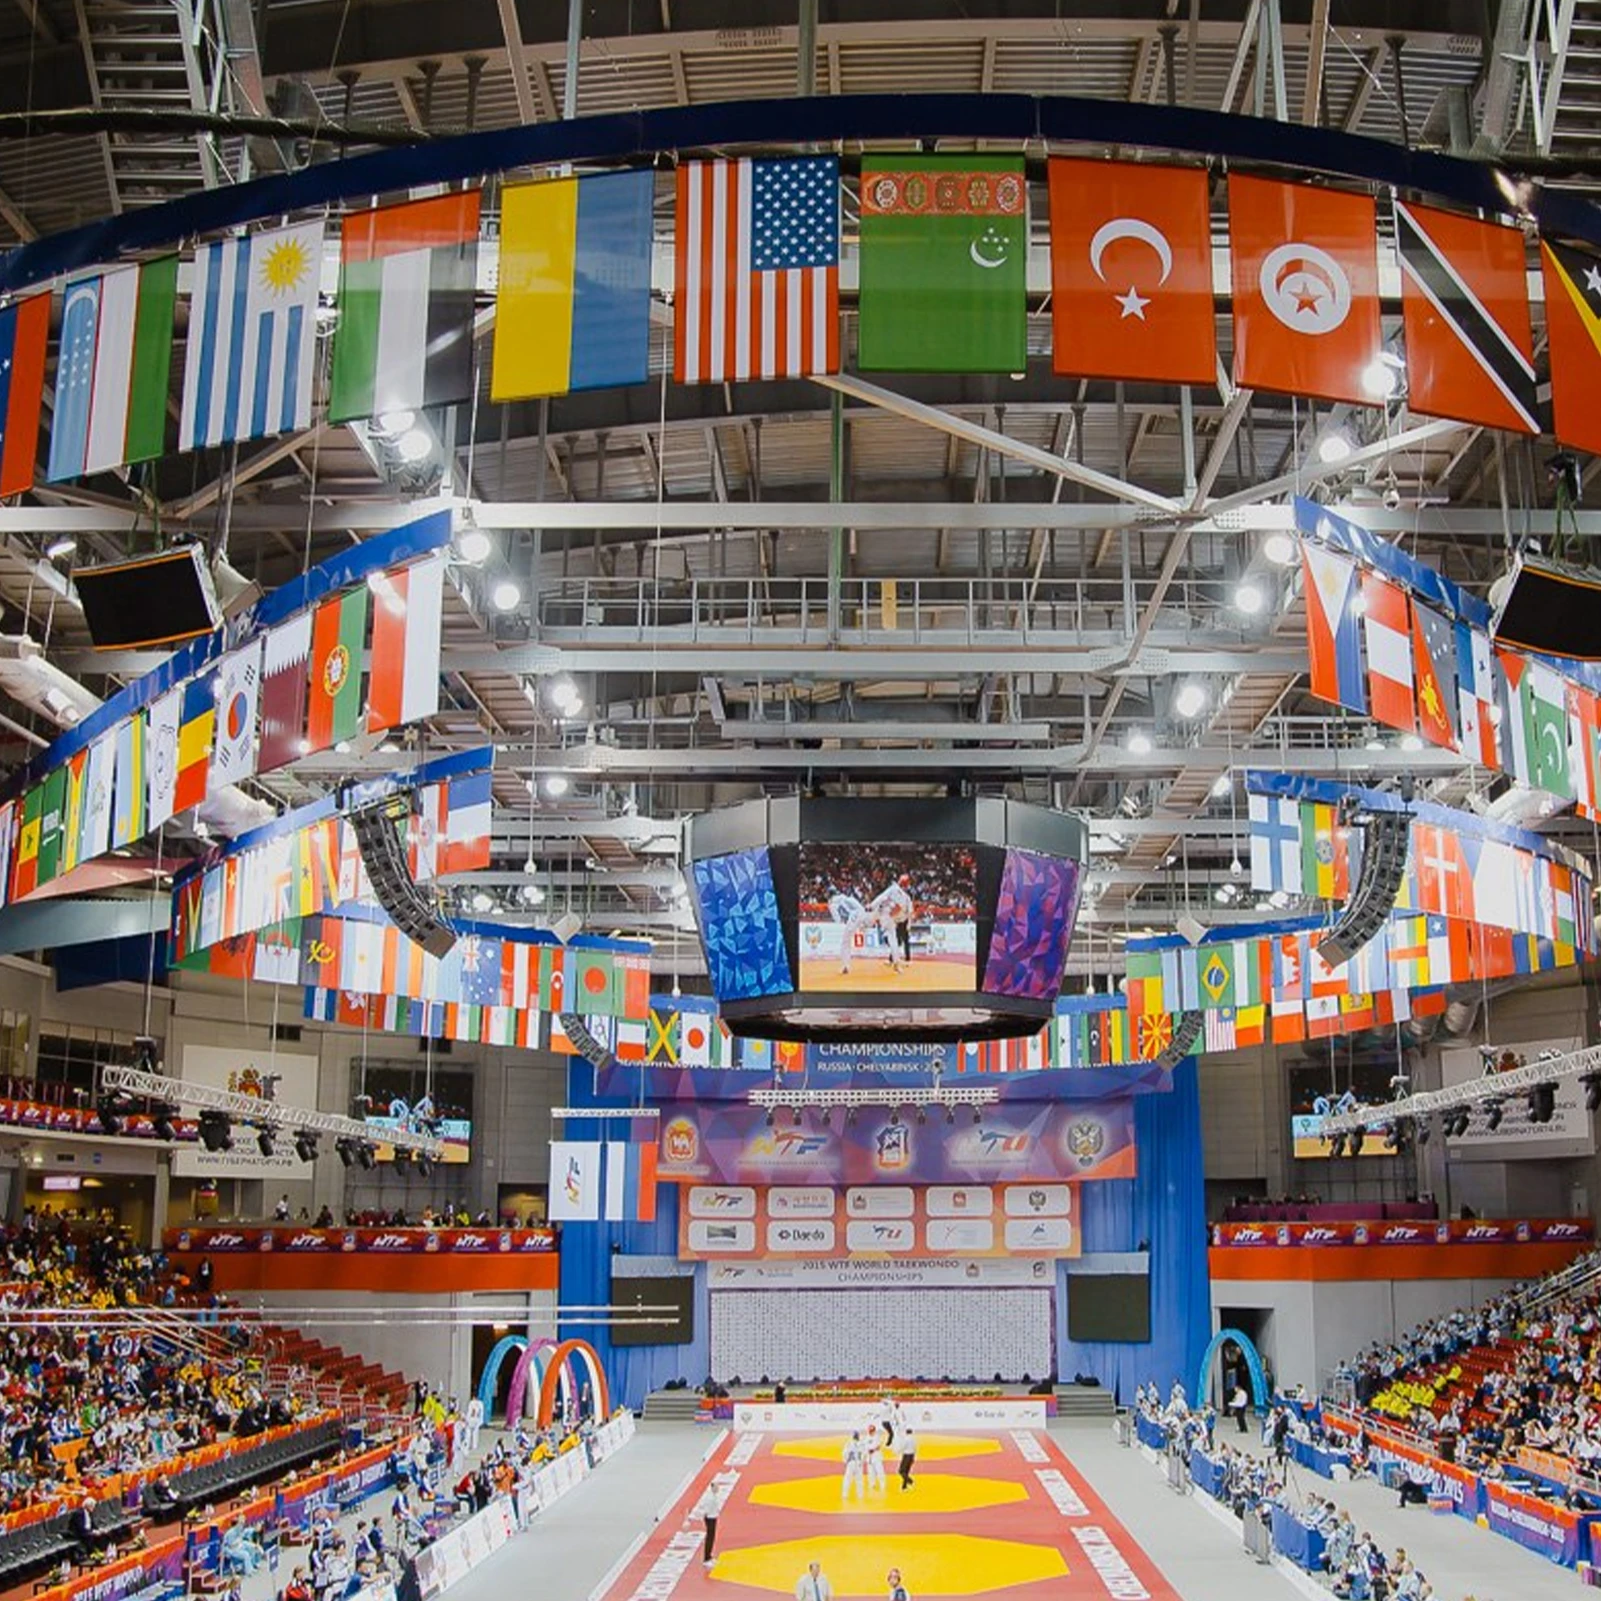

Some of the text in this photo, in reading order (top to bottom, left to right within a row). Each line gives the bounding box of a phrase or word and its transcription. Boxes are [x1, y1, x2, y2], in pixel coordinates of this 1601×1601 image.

[819, 1042, 946, 1057] CHAMPIONSHIPS
[802, 1260, 960, 1270] 2015 WTF WORLD TAEKWONDO
[837, 1271, 924, 1283] CHAMPIONSHIPS
